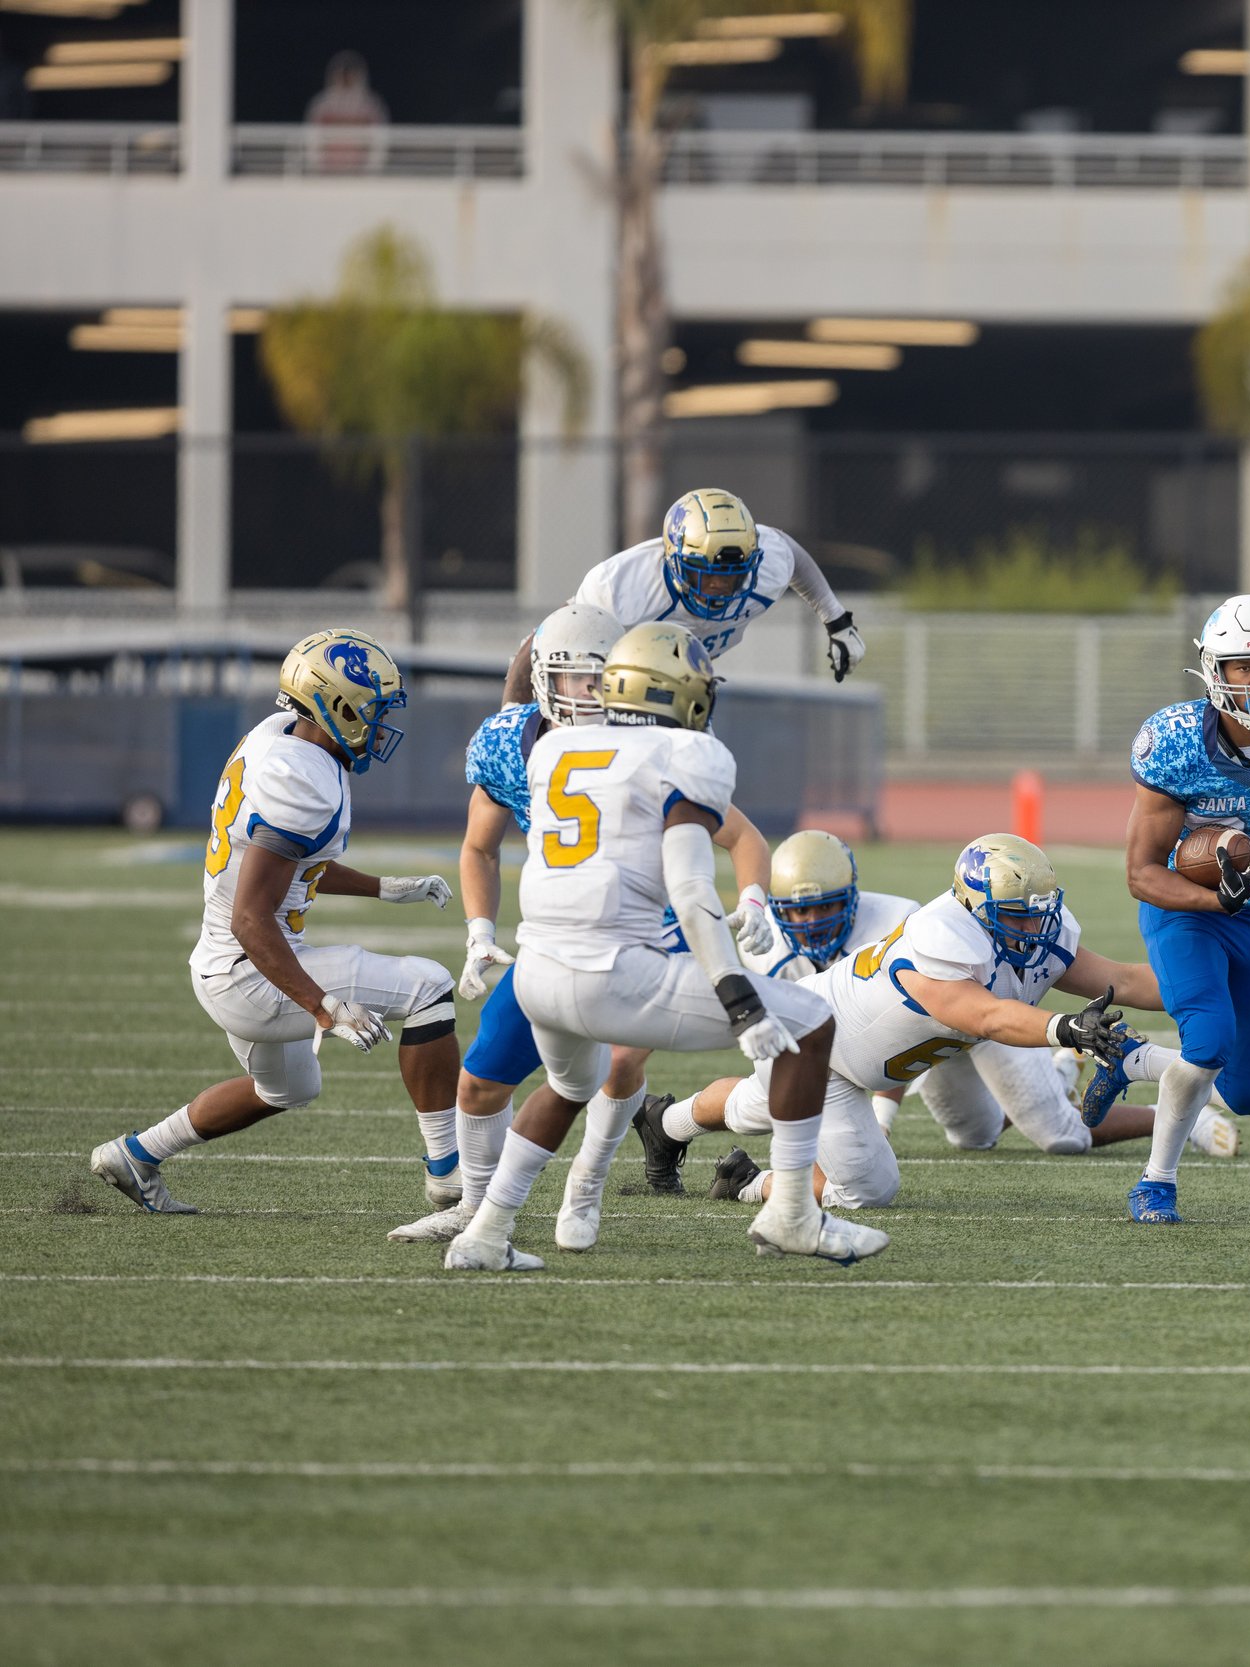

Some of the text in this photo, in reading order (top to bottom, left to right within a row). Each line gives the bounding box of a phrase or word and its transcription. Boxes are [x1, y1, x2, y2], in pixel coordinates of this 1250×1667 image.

[606, 708, 657, 726] Riddell
[1165, 704, 1197, 732] 32
[542, 749, 619, 869] 5
[1196, 796, 1247, 813] SANTA
